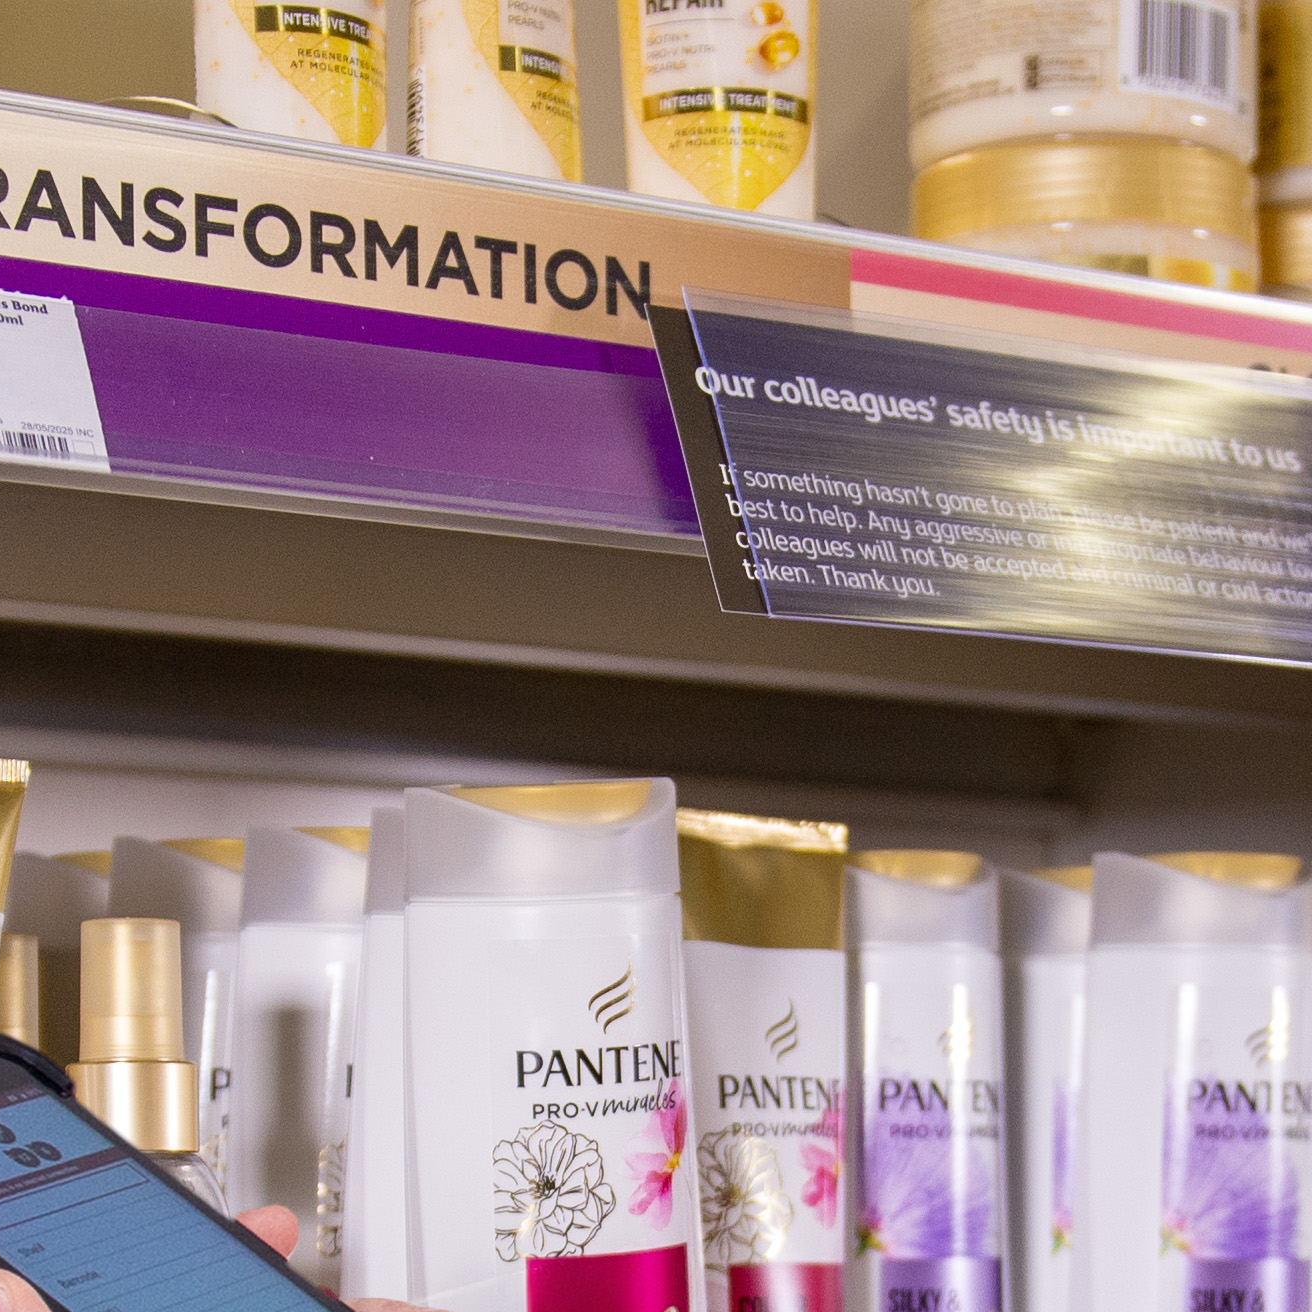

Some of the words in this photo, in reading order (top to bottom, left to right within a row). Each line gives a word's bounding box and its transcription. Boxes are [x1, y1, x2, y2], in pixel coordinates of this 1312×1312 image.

[12, 300, 49, 315] Bond
[694, 366, 756, 400] Our
[944, 400, 1045, 444] safety
[1045, 410, 1075, 442] is
[1076, 415, 1228, 464] important
[1230, 438, 1263, 468] to
[1266, 447, 1304, 474] us
[718, 463, 737, 487] If
[743, 467, 864, 506] something
[935, 493, 990, 517] gone
[991, 495, 1016, 518] to
[1139, 511, 1165, 537] be
[1168, 516, 1237, 546] patient
[726, 493, 775, 521] best
[780, 498, 804, 523] to
[806, 499, 863, 533] help.
[867, 510, 911, 540] Any
[914, 519, 1024, 549] aggressive
[1026, 530, 1048, 550] or
[735, 527, 855, 560] colleagues
[857, 538, 896, 563] will
[900, 544, 938, 568] not
[941, 546, 968, 570] be
[973, 552, 1067, 582] accepted
[1113, 567, 1193, 595] criminal
[1197, 580, 1219, 599] or
[1221, 580, 1260, 602] civil
[742, 557, 815, 585] taken.
[816, 563, 889, 593] Thank
[892, 575, 942, 600] you.
[515, 1039, 681, 1089] PANTENE
[532, 1101, 599, 1120] PRO-V
[601, 1076, 677, 1116] miracles
[878, 1078, 1000, 1113] PANEN
